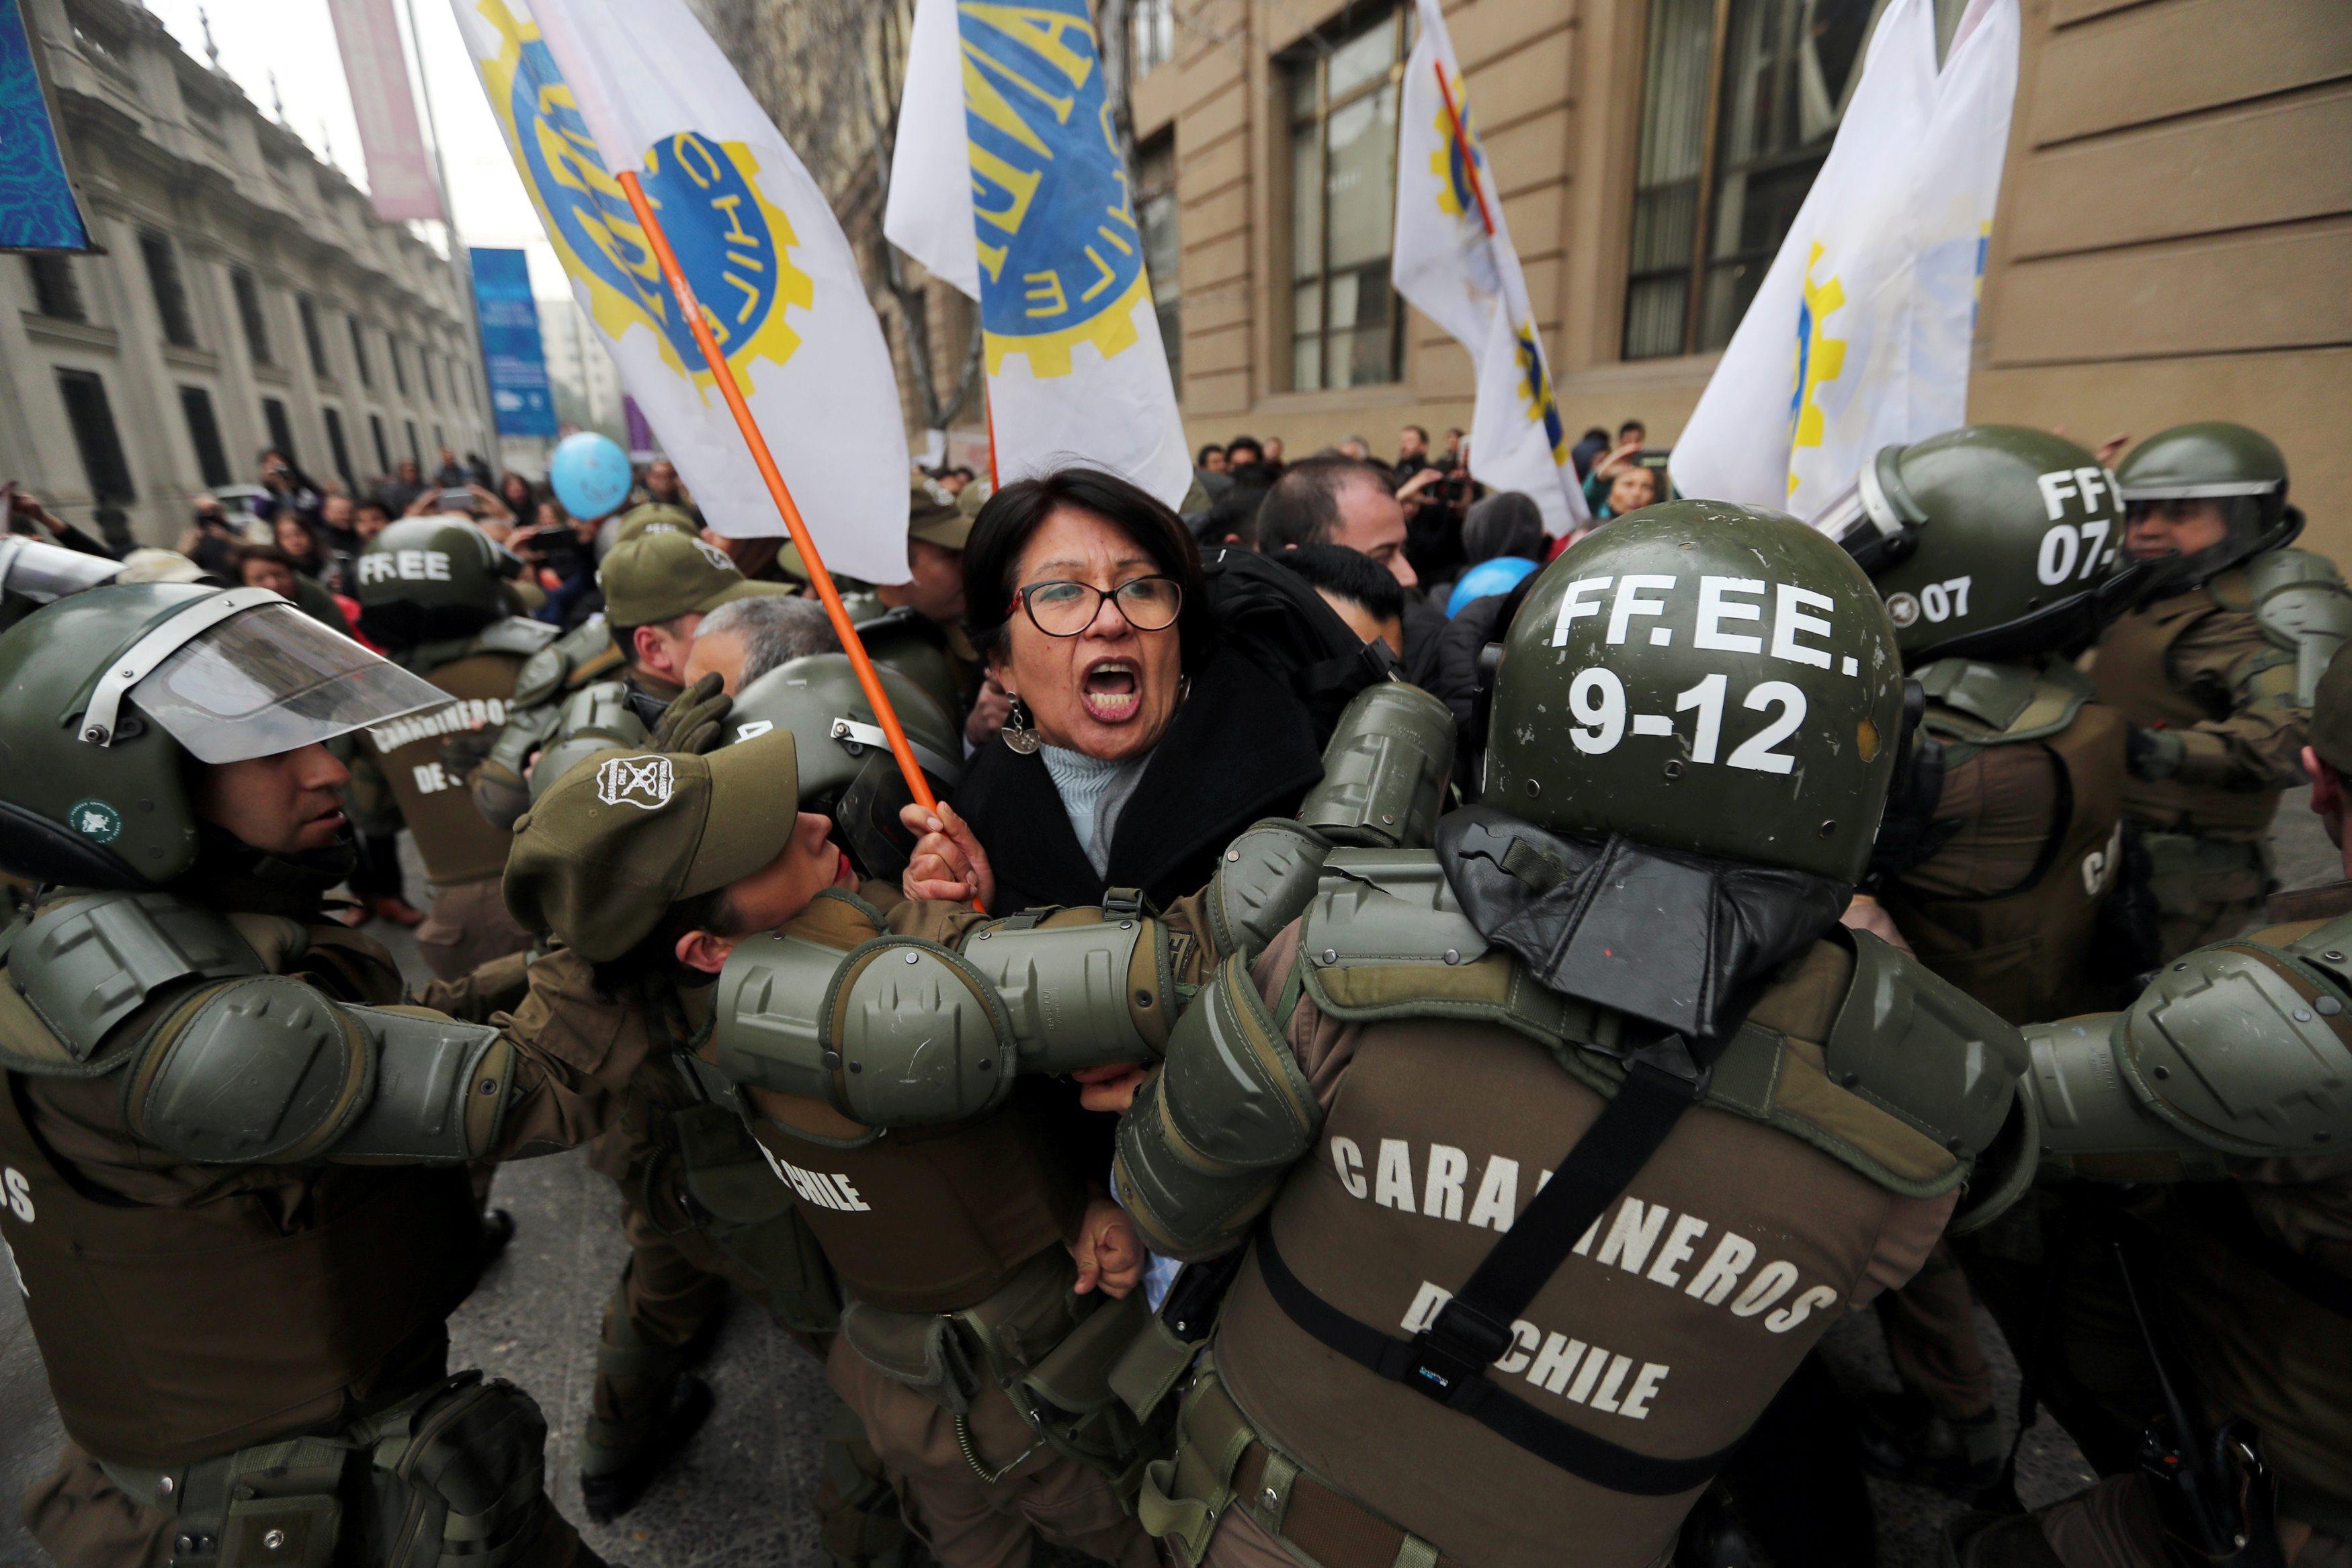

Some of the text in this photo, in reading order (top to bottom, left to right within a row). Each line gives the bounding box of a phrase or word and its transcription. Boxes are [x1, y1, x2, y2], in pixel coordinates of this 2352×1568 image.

[1920, 574, 1972, 623] 07
[1568, 667, 1808, 775] 9-12
[780, 1157, 872, 1211] CHILE
[1330, 1136, 1837, 1334] CARANEROS
